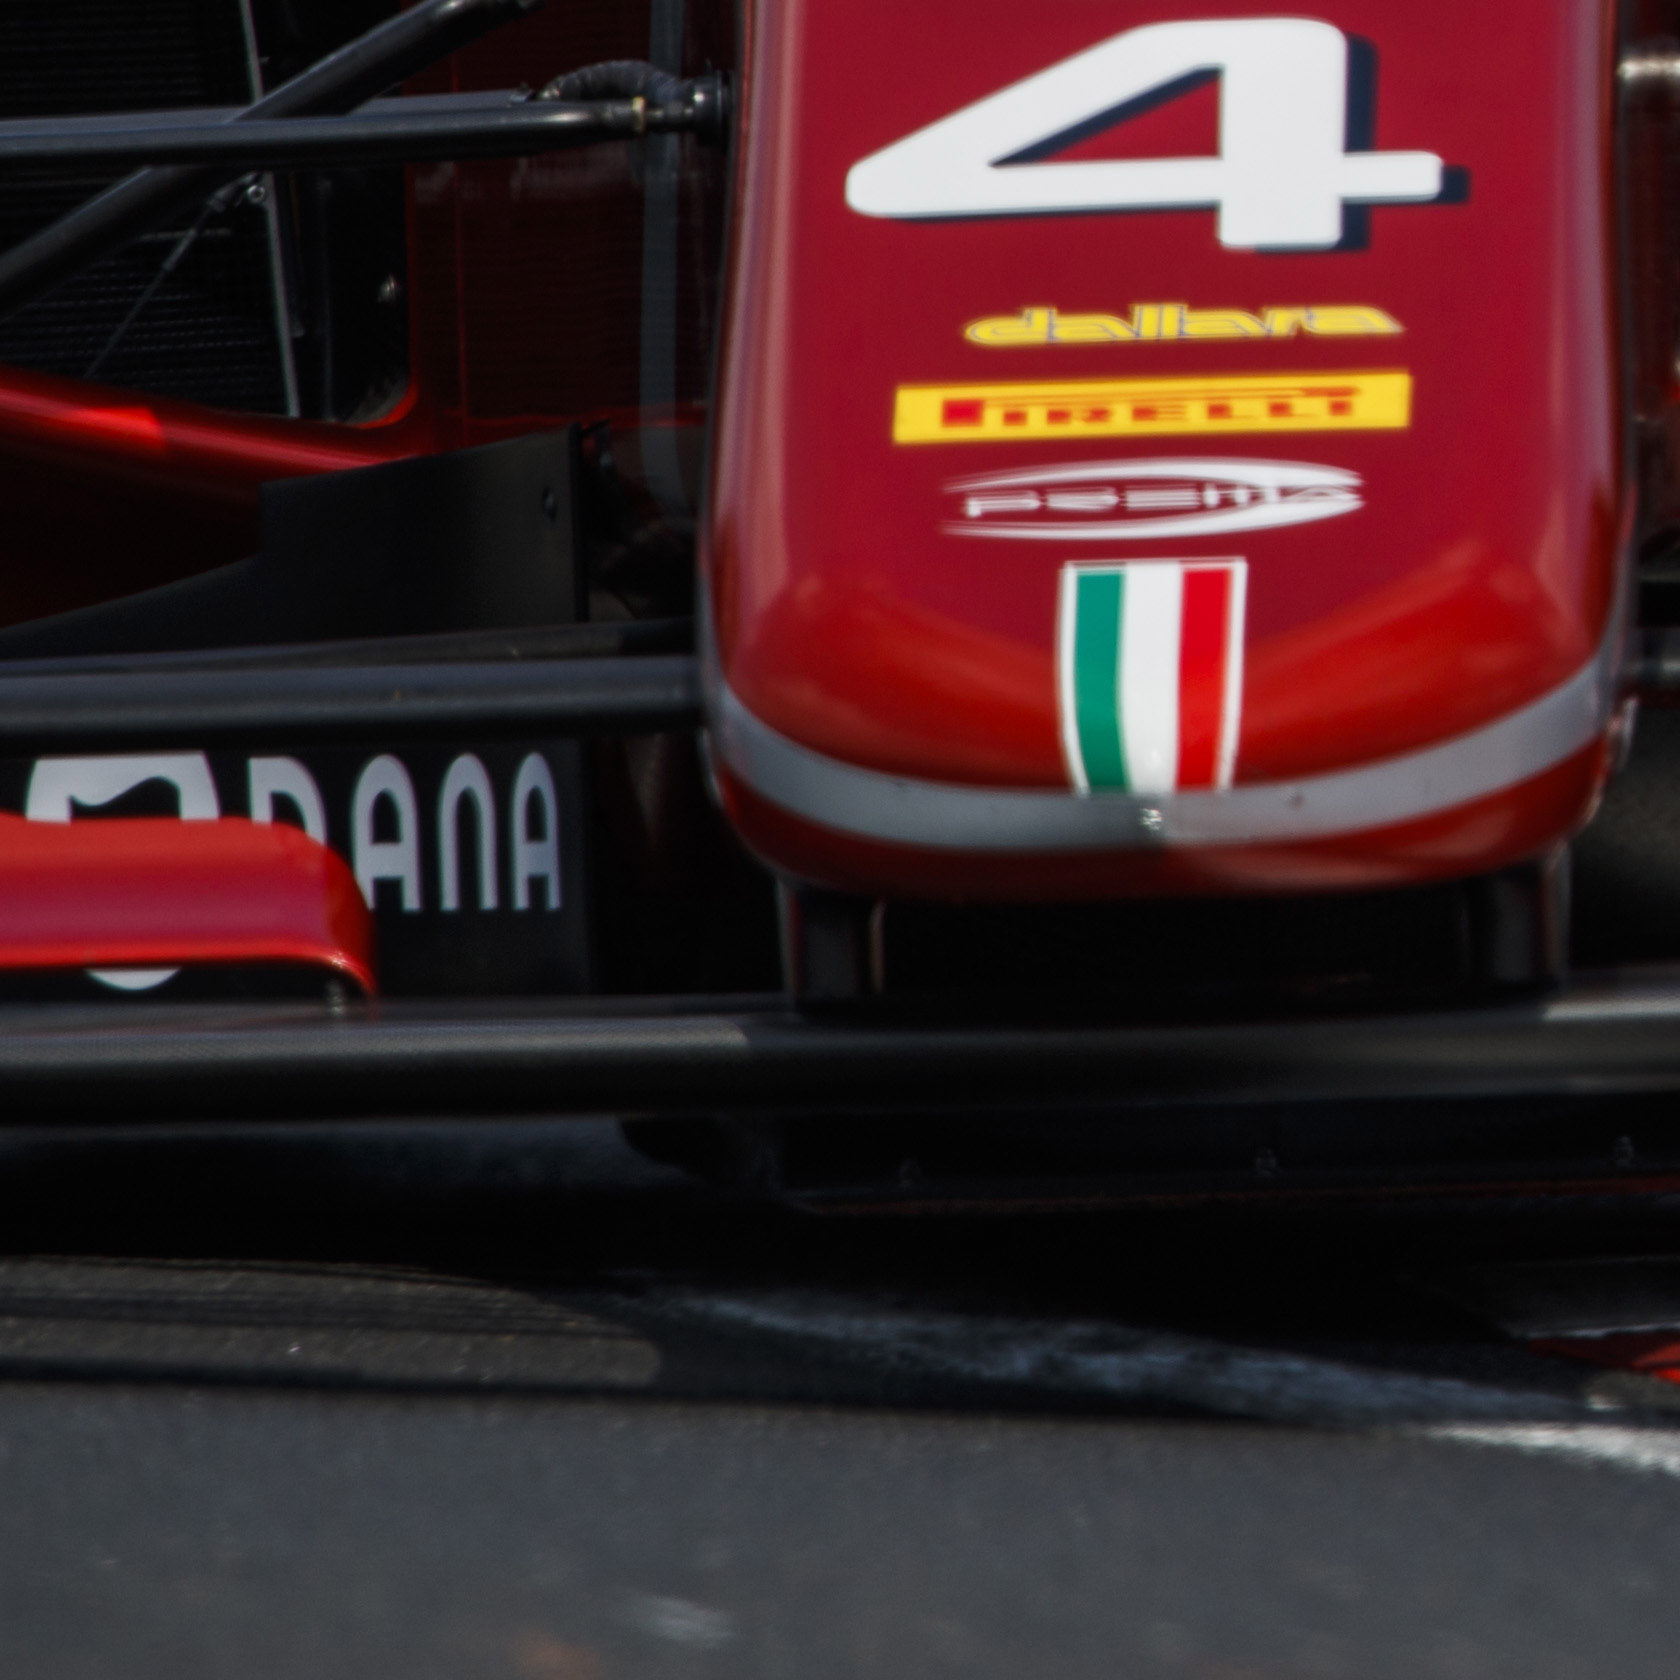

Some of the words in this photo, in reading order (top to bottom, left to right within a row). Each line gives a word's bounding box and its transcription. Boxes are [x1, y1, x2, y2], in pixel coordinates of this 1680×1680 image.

[846, 16, 1460, 252] 4
[964, 302, 1405, 347] dallara
[939, 383, 1362, 428] PIRELLI
